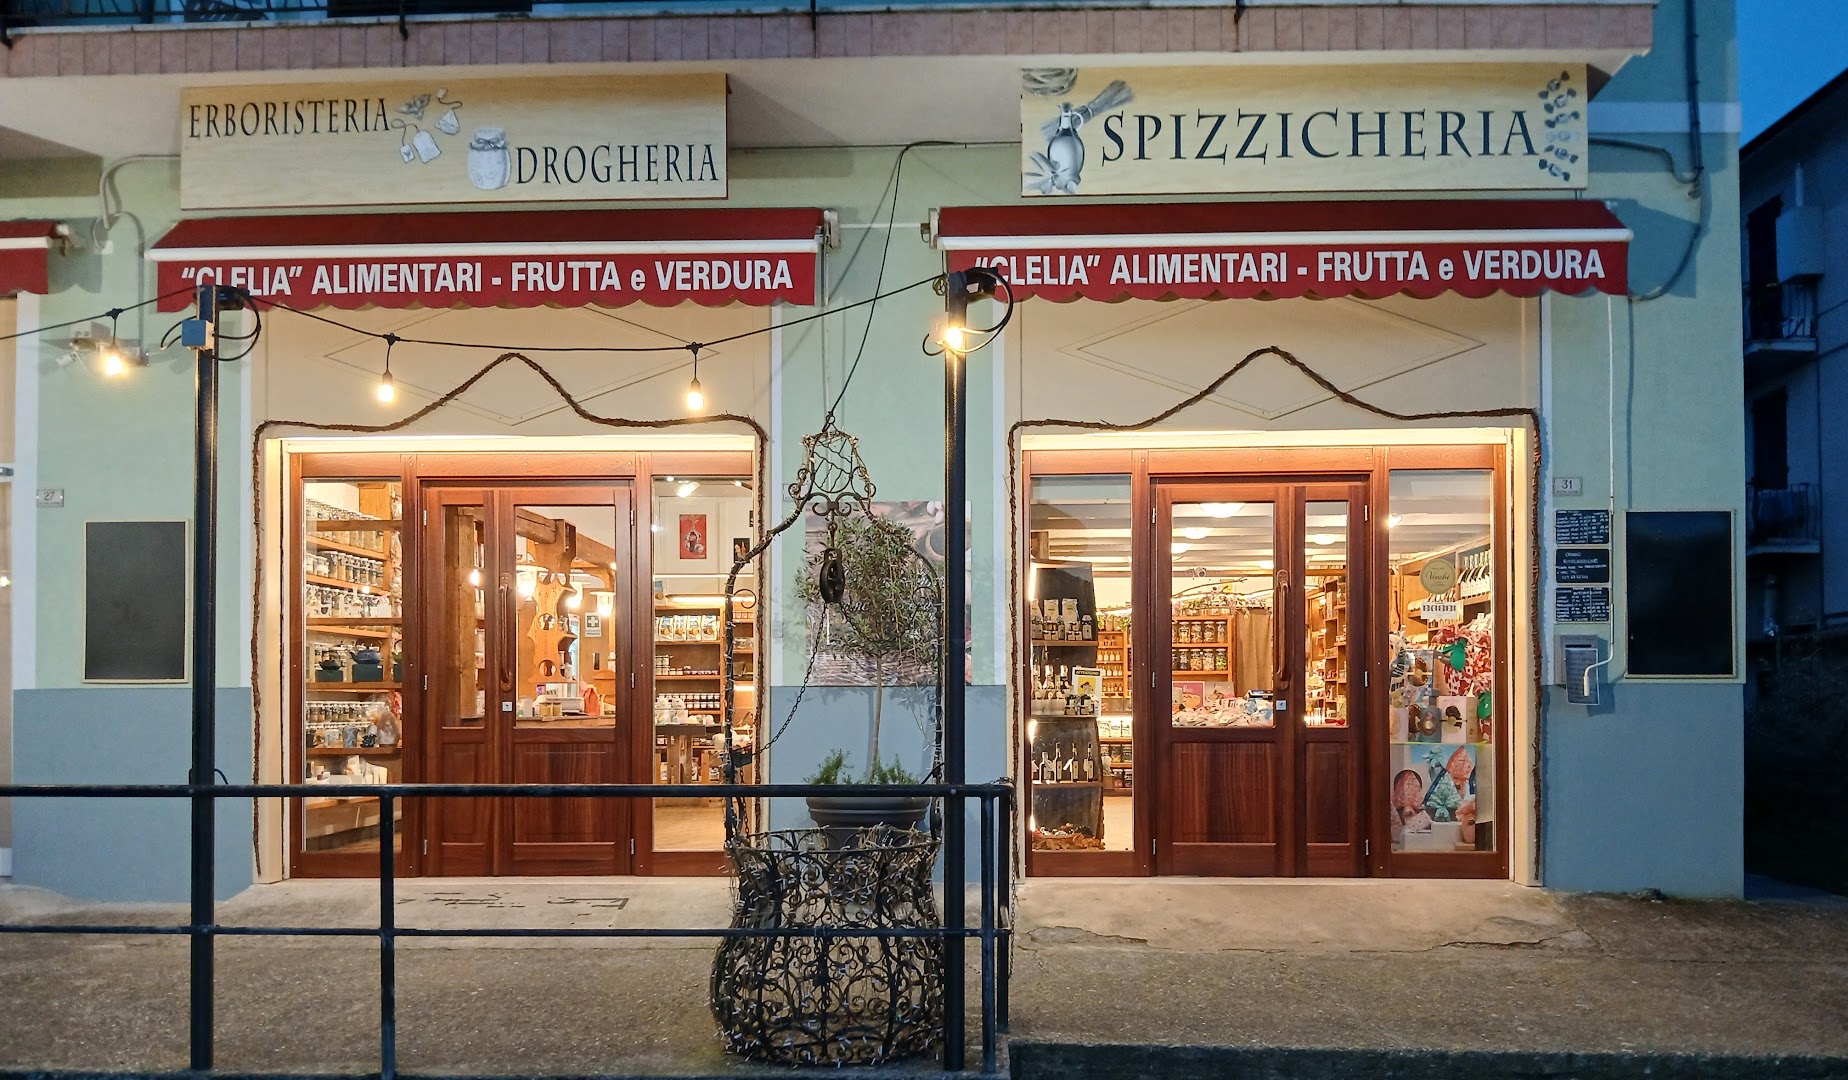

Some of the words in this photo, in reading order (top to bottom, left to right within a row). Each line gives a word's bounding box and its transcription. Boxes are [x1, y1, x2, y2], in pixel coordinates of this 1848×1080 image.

[189, 97, 391, 139] ERBORISTERIA
[1102, 107, 1539, 166] SPIZZICHERIA
[516, 143, 719, 185] DROGHERIA
[311, 262, 482, 295] ALIMENTARI
[511, 261, 622, 292] FRUTTA
[630, 269, 646, 291] e
[655, 259, 793, 291] VERDURA
[1110, 252, 1287, 285] ALIMENTARI
[1297, 266, 1308, 276] -
[1318, 250, 1430, 282] FRUTTA
[1438, 258, 1454, 281] e
[1463, 249, 1605, 280] VERDURA
[44, 491, 55, 501] 27
[1562, 479, 1573, 490] 31
